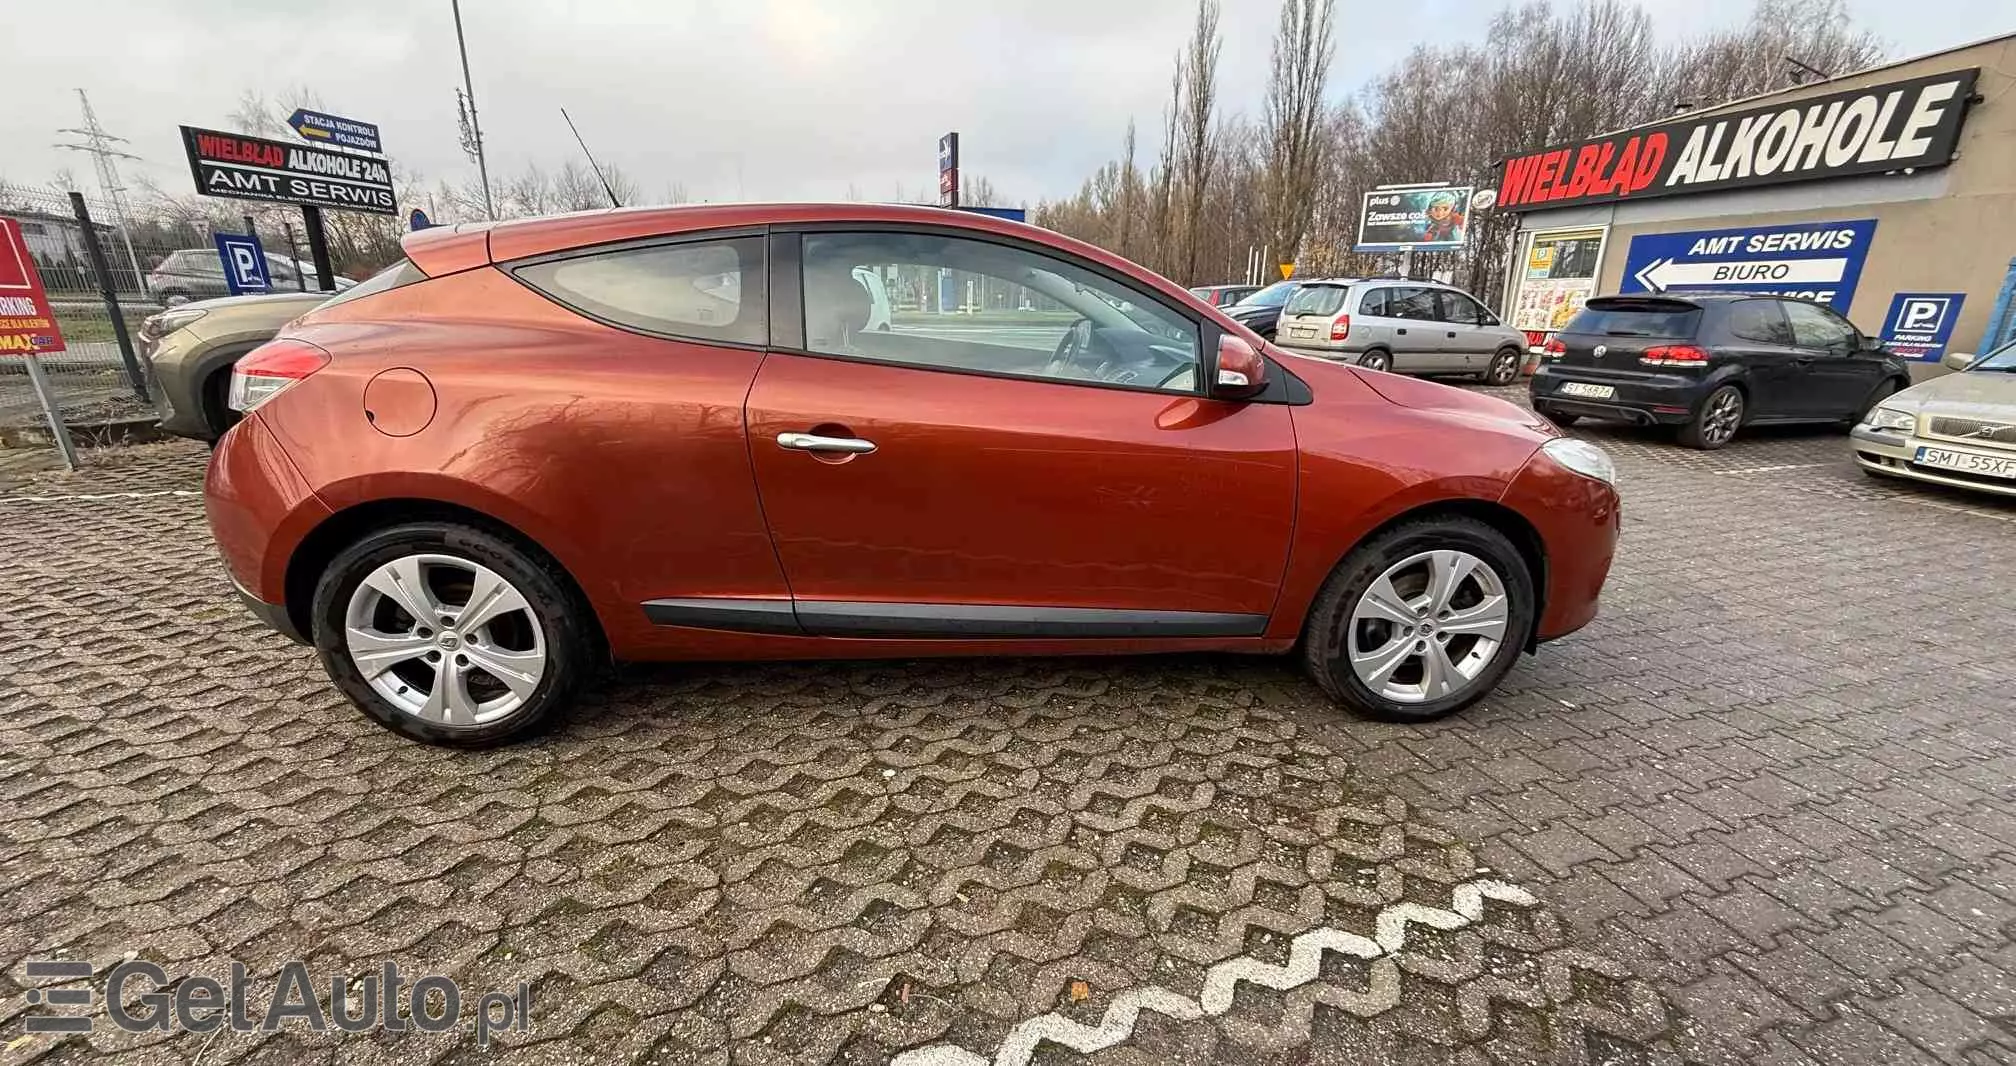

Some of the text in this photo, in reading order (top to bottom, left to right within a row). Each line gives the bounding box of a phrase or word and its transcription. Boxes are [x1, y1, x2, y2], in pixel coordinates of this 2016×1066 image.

[303, 114, 375, 137] STACJA KONTROLI
[335, 132, 377, 148] POJAZDÓW
[1497, 80, 1960, 207] WIELBŁĄD ALKOHOLE
[288, 149, 362, 179] ALKOHOLE
[362, 161, 389, 183] 24h
[209, 169, 393, 207] AMT SERWIS
[1369, 196, 1389, 207] plus
[1368, 211, 1407, 222] Zawsze
[1688, 229, 1855, 256] AMT SERWIS
[233, 247, 255, 283] P
[1713, 264, 1790, 281] BIURO
[1904, 302, 1938, 329] P
[1927, 450, 2015, 473] SMI 55XF
